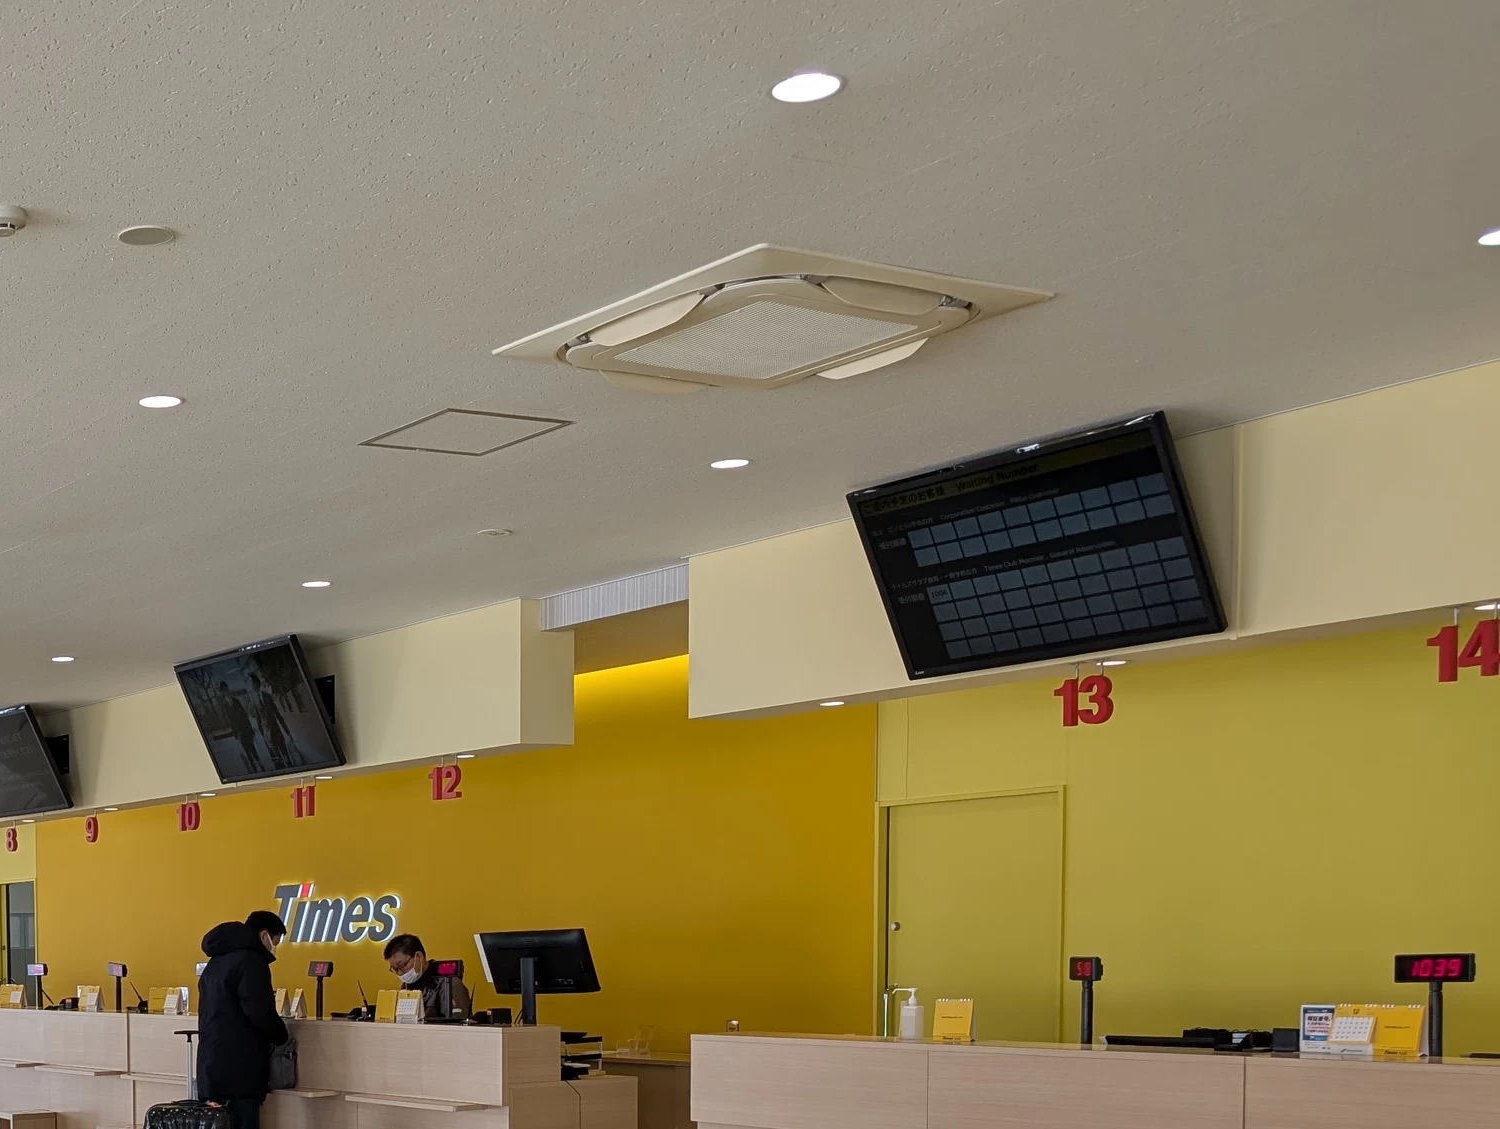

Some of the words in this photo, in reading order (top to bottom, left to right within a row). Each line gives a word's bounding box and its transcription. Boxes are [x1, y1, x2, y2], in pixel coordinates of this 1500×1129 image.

[994, 461, 1040, 481] Number
[1426, 619, 1500, 682] 14
[1054, 675, 1114, 727] 13
[428, 765, 462, 800] 12
[176, 802, 200, 831] 10
[290, 786, 315, 818] 11
[6, 828, 18, 852] 8
[86, 816, 99, 842] 9
[274, 883, 400, 943] Times
[1411, 958, 1462, 976] 1039
